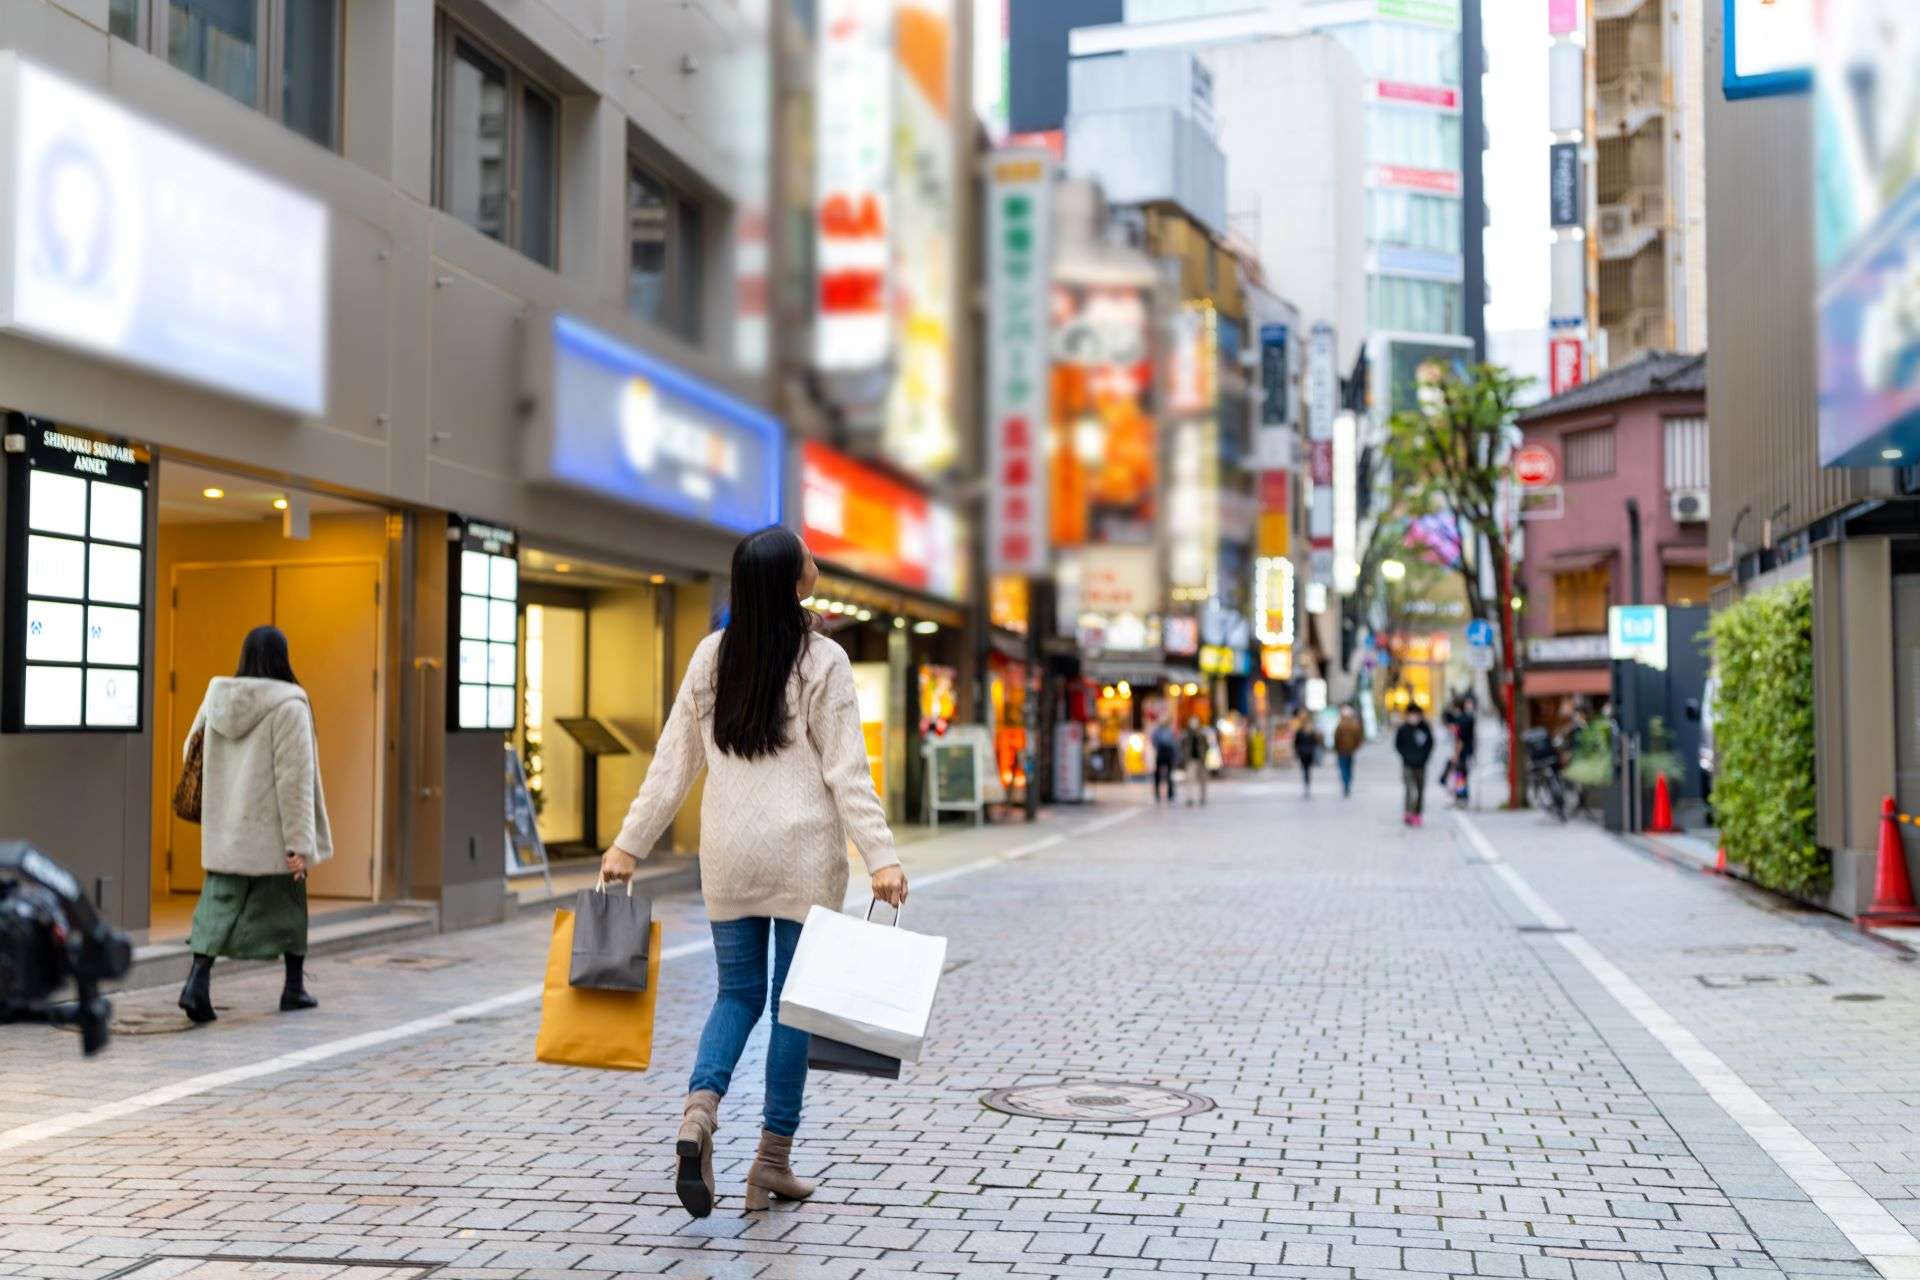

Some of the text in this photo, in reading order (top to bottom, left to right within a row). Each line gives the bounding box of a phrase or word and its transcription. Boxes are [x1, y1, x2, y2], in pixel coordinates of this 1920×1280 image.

[43, 430, 136, 464] SHINJUKU SUNPARK
[74, 455, 108, 476] ANNEX
